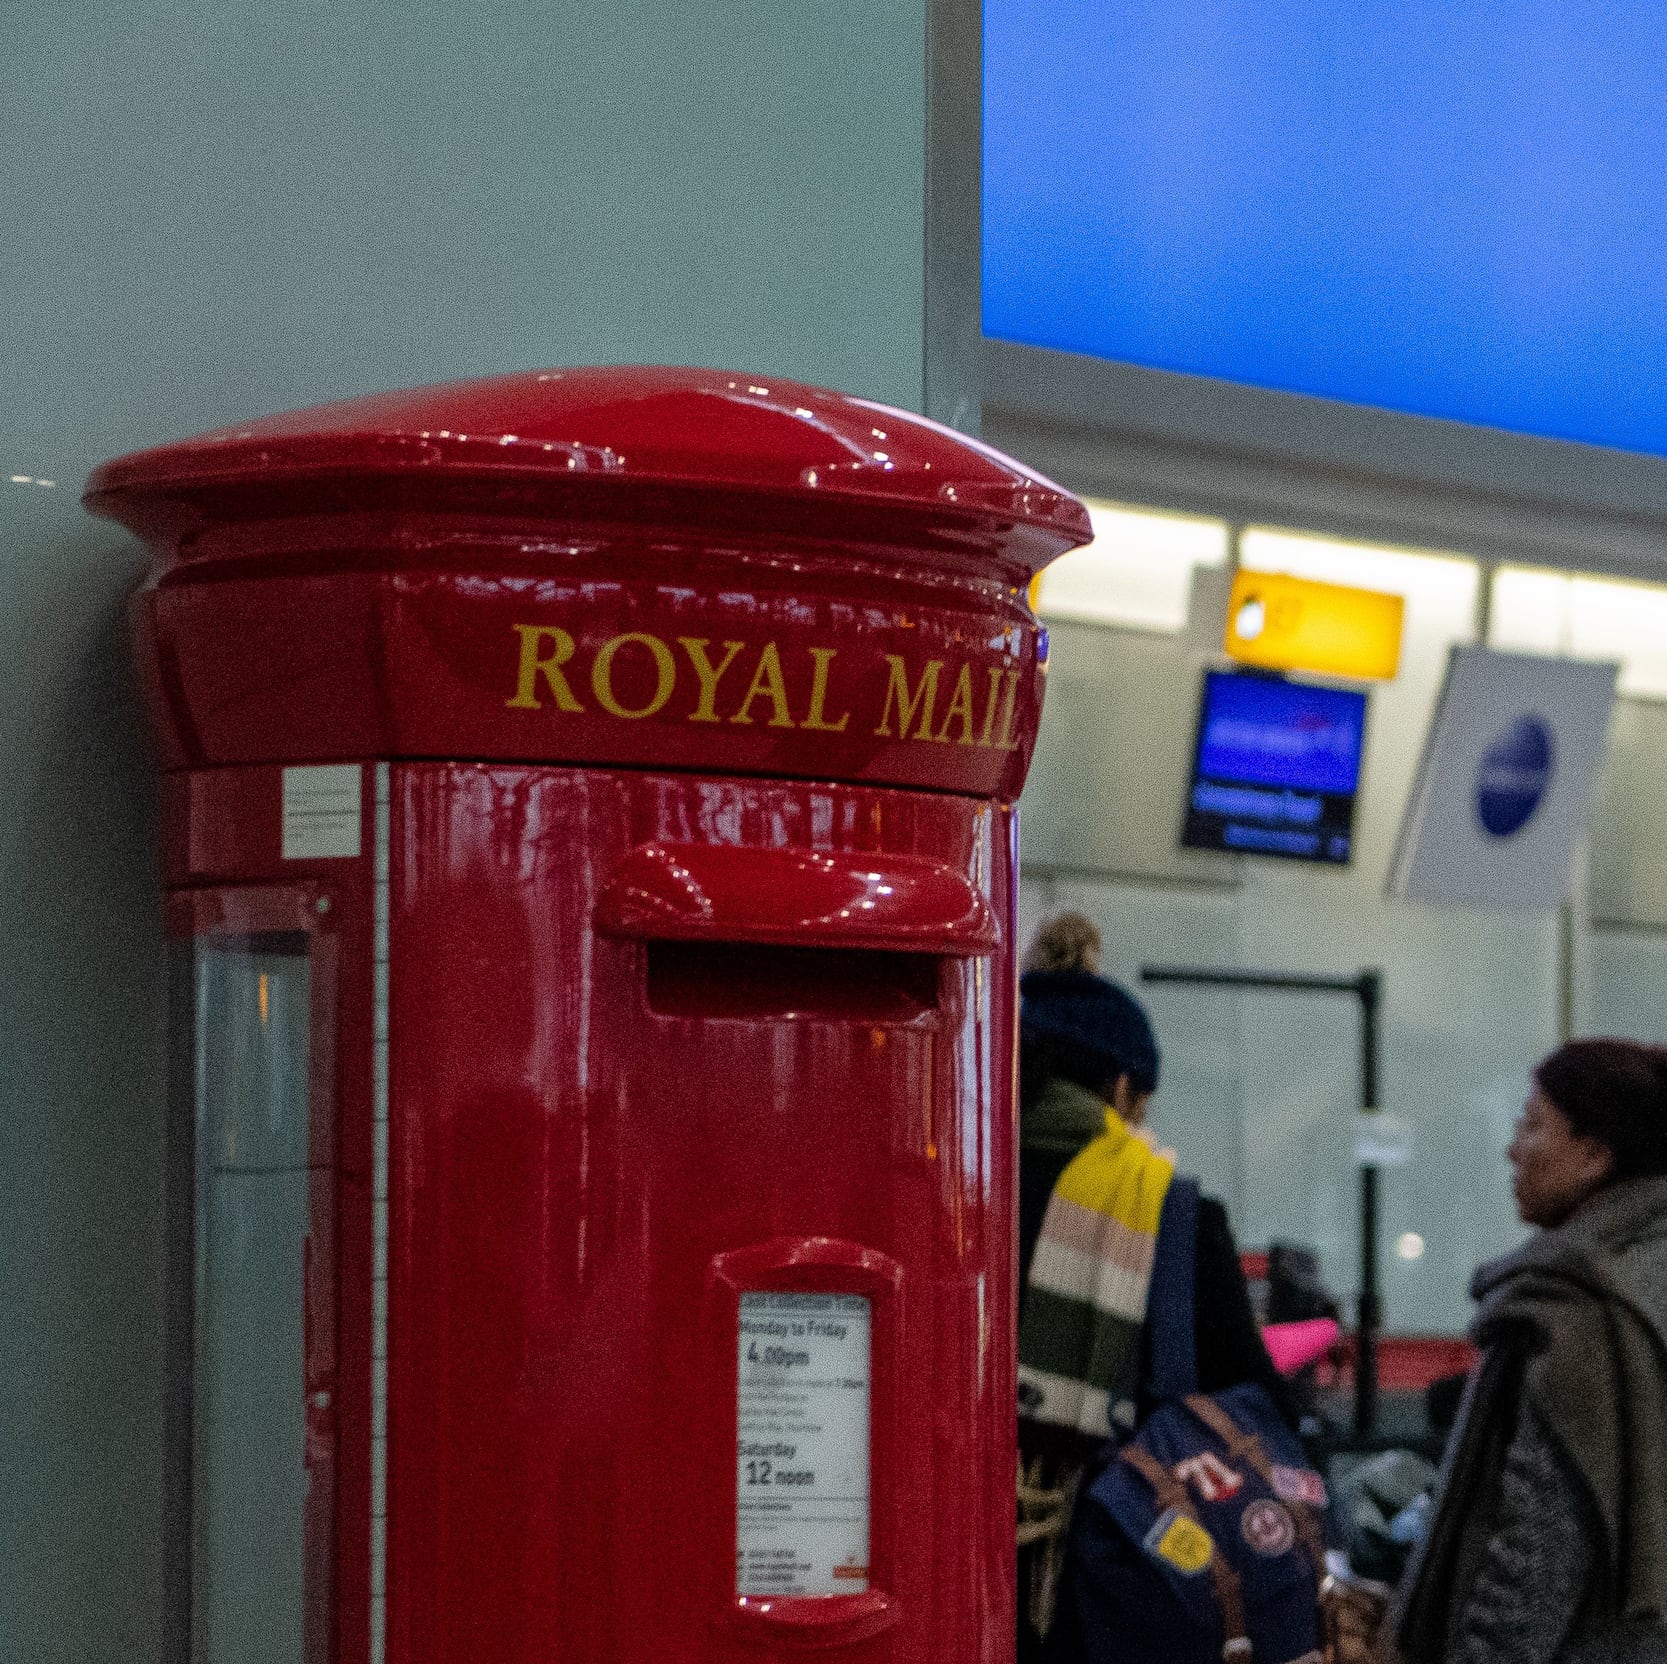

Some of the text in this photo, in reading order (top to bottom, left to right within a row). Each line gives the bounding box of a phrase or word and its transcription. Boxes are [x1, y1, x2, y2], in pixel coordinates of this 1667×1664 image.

[505, 623, 1022, 751] ROYAL MAIL
[746, 1461, 815, 1486] 12 noon
